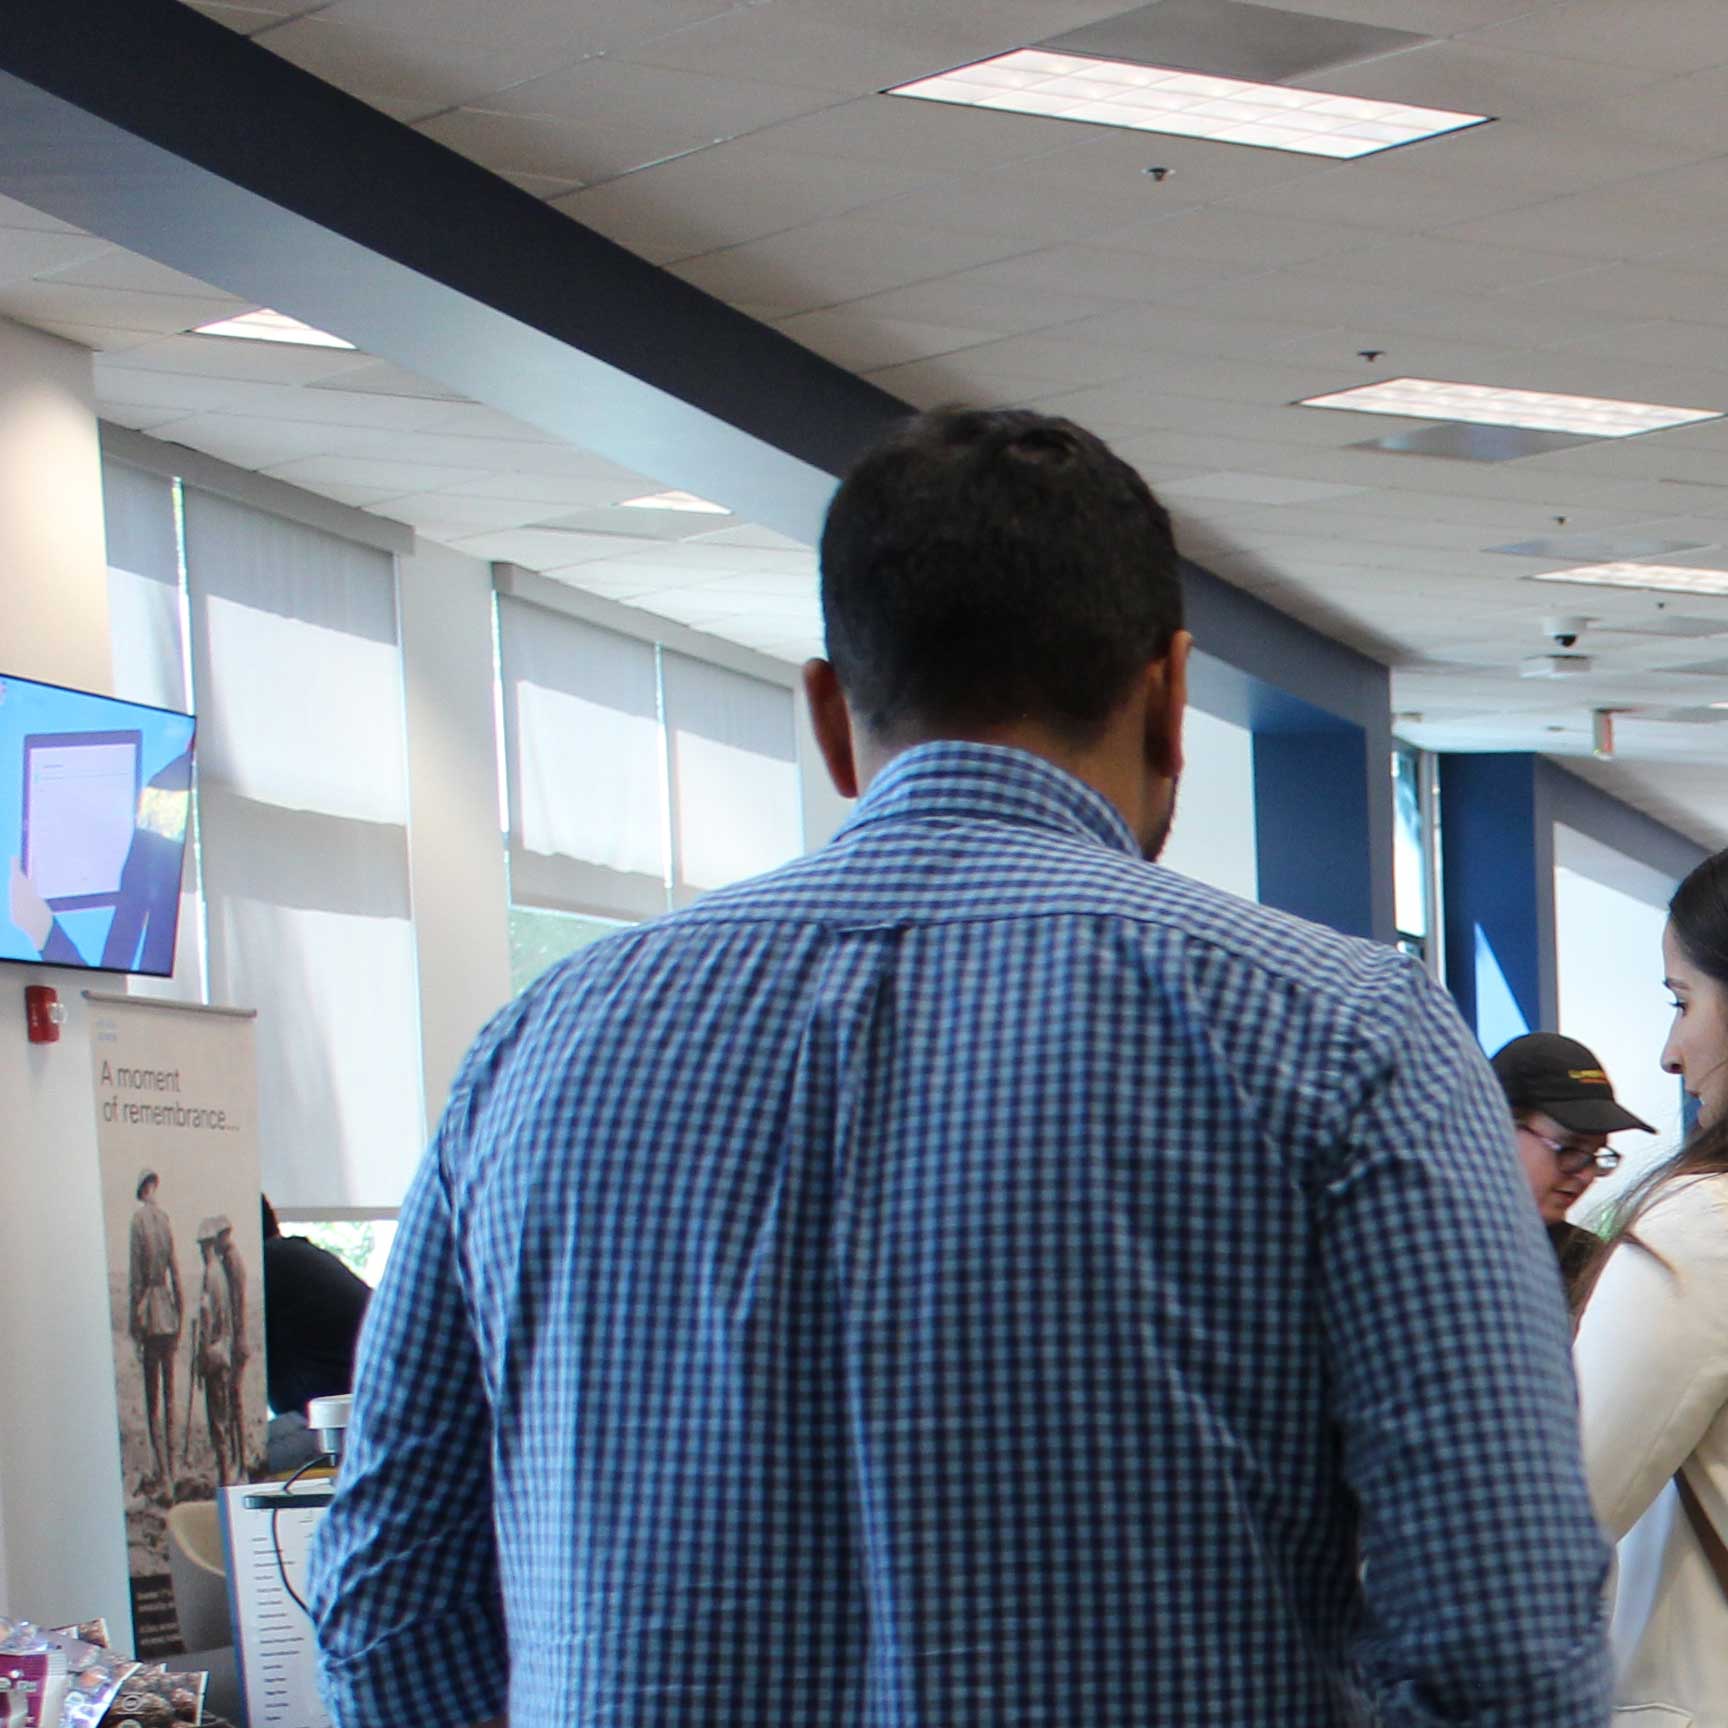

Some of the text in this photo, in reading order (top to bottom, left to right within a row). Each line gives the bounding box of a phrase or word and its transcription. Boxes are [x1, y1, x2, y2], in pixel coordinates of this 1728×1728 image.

[101, 1060, 181, 1093] A moment
[103, 1095, 240, 1132] of remembrance...
